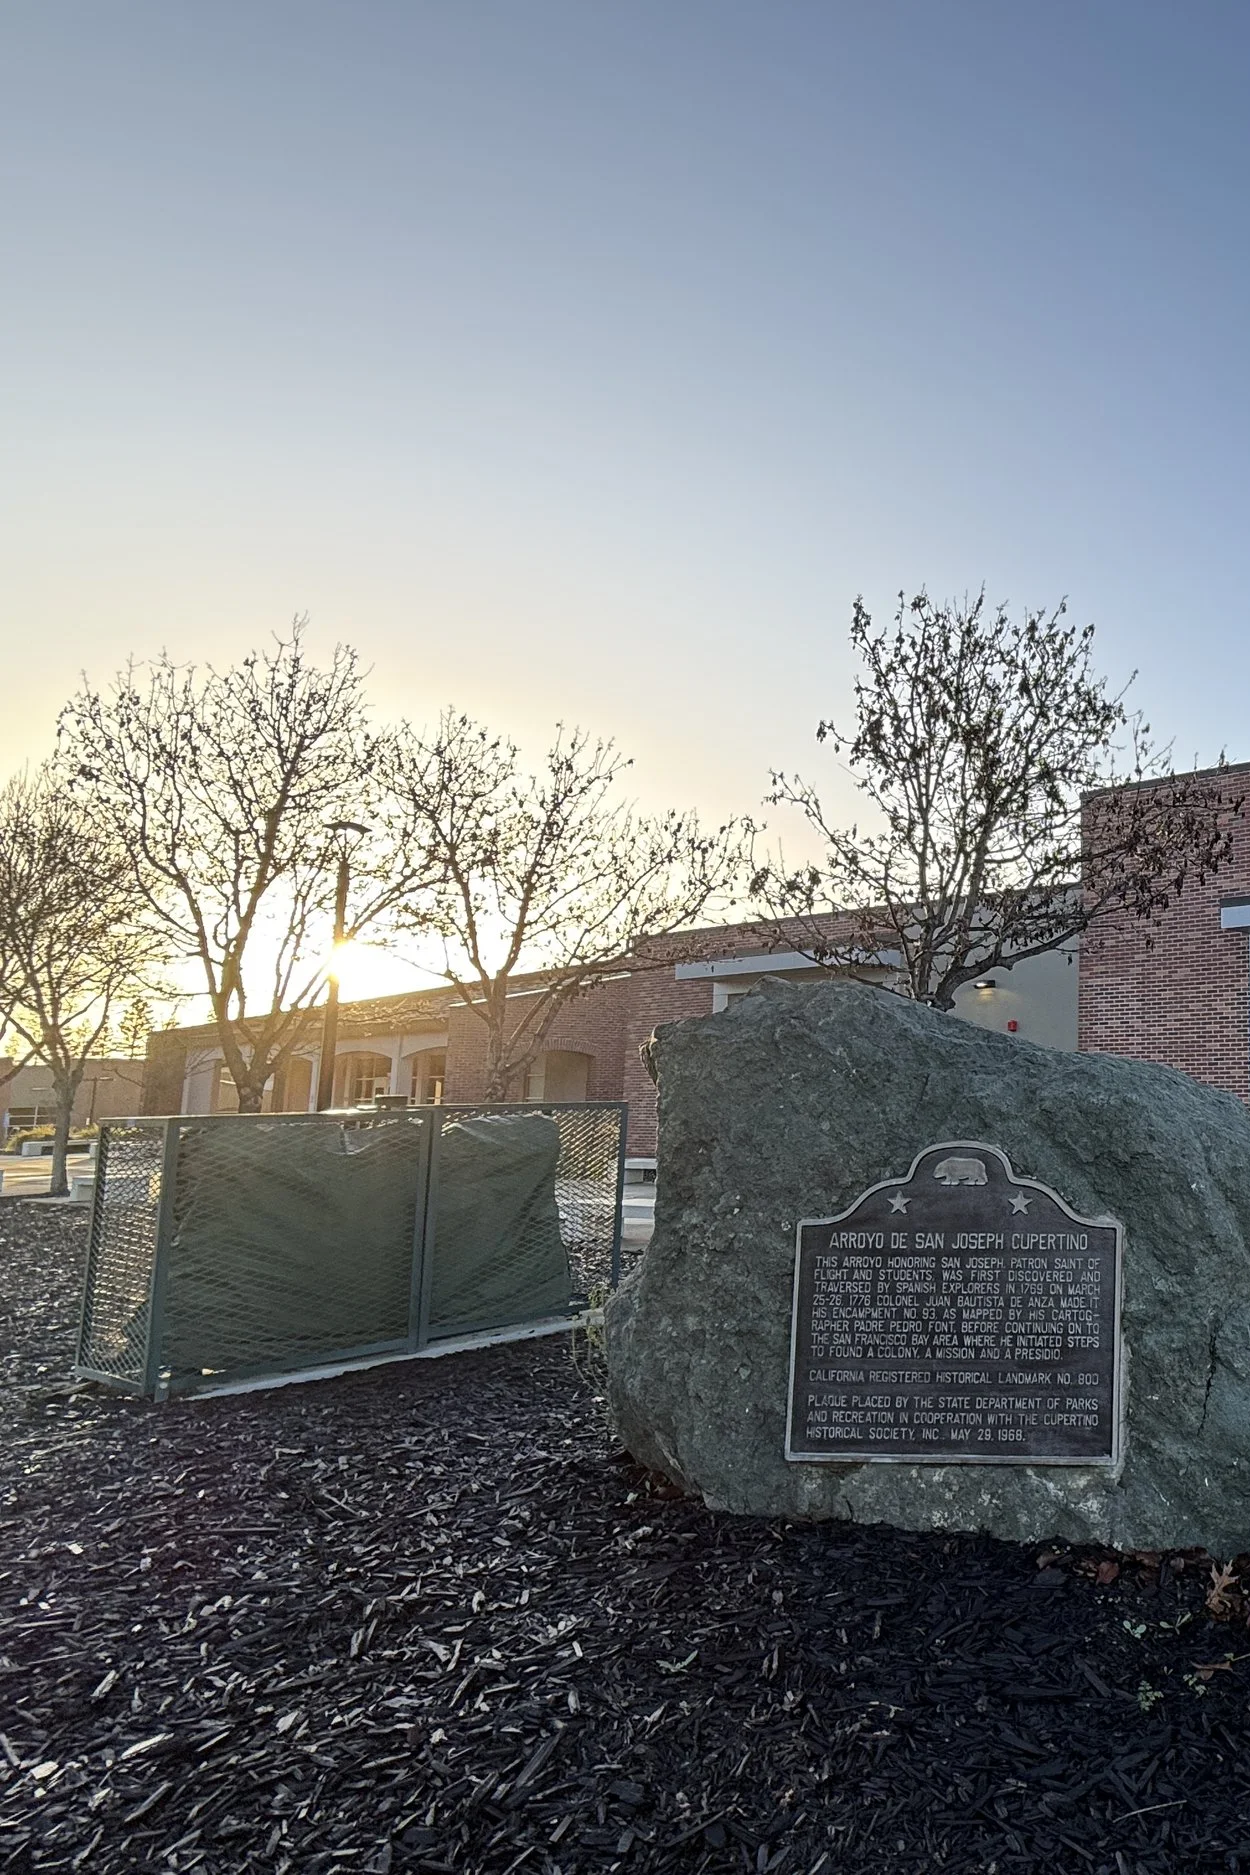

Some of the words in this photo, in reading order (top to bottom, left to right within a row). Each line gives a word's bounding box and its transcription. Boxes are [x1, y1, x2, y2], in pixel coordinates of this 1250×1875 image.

[829, 1232, 884, 1249] ARROYO
[891, 1233, 908, 1249] DE
[915, 1233, 944, 1249] SAN
[952, 1233, 1004, 1249] JOSEPH
[1012, 1234, 1088, 1250] CUPERTINO
[816, 1256, 838, 1267] THIS
[843, 1256, 882, 1268] ARROYO
[888, 1257, 936, 1268] HONORING
[941, 1257, 960, 1268] SAN
[1011, 1258, 1047, 1269] PATRON
[1054, 1258, 1083, 1269] SAINT
[1088, 1258, 1100, 1269] OF
[814, 1269, 848, 1280] FLIGHT
[853, 1269, 872, 1280] AND
[942, 1270, 963, 1281] WAS
[971, 1270, 1000, 1281] FIRST
[1008, 1271, 1073, 1282] DISCOVERED
[1081, 1271, 1100, 1282] AND
[815, 1282, 871, 1293] TRAVERSED
[877, 1282, 890, 1293] BY
[896, 1282, 936, 1293] SPANISH
[942, 1283, 1000, 1294] EXPLORERS
[1006, 1284, 1015, 1294] IN
[1050, 1284, 1063, 1294] ON
[1068, 1284, 1100, 1295] MARCH
[850, 1295, 870, 1305] 1776
[877, 1295, 919, 1306] COLONEL
[926, 1296, 950, 1306] JUAN
[958, 1296, 1004, 1307] BAUTISTA
[1011, 1297, 1023, 1307] DE
[1028, 1297, 1055, 1307] ANZA
[1060, 1297, 1086, 1308] MADE
[1089, 1297, 1100, 1308] IT
[812, 1308, 826, 1318] HIS
[833, 1308, 897, 1319] ENCAMPMENT
[943, 1309, 956, 1319] AS
[963, 1309, 1002, 1320] MAPPED
[1009, 1309, 1022, 1320] BY
[1029, 1310, 1045, 1320] HIS
[1052, 1310, 1100, 1321] CARTOG-
[811, 1320, 849, 1331] RAPHER
[854, 1321, 884, 1332] PADRE
[890, 1321, 922, 1332] PEDRO
[962, 1322, 999, 1333] BEFORE
[1005, 1322, 1063, 1333] CONTINUING
[1068, 1323, 1081, 1333] ON
[1087, 1323, 1099, 1334] TO
[811, 1333, 829, 1344] THE
[833, 1334, 850, 1344] SAN
[855, 1334, 906, 1345] FRANCISCO
[912, 1335, 930, 1345] BAY
[933, 1335, 958, 1346] AREA
[964, 1335, 996, 1346] WHERE
[1000, 1336, 1013, 1346] HE
[1017, 1336, 1062, 1347] INITIATED
[1068, 1336, 1099, 1347] STEPS
[811, 1346, 823, 1357] TO
[830, 1346, 862, 1357] FOUND
[867, 1347, 873, 1357] A
[925, 1347, 932, 1358] A
[936, 1348, 974, 1359] MISSION
[980, 1348, 1000, 1359] AND
[1005, 1349, 1011, 1359] A
[1015, 1349, 1063, 1360] PRESIDIO.
[809, 1370, 864, 1382] CALIFORNIA
[870, 1371, 931, 1383] REGISTERED
[936, 1372, 992, 1384] HISTORICAL
[998, 1372, 1051, 1384] LANDMARK
[808, 1395, 847, 1407] PLAQUE
[852, 1396, 891, 1407] PLACED
[896, 1397, 909, 1407] BY
[914, 1397, 934, 1408] THE
[939, 1397, 970, 1408] STATE
[976, 1397, 1042, 1409] DEPARTMENT
[1047, 1398, 1060, 1409] OF
[1066, 1398, 1098, 1410] PARKS
[807, 1411, 827, 1422] AND
[832, 1411, 894, 1423] RECREATION
[900, 1412, 908, 1423] IN
[914, 1412, 982, 1424] COOPERATION
[988, 1413, 1012, 1425] WITH
[1019, 1414, 1038, 1425] THE
[1044, 1414, 1098, 1426] CUPERTINO
[806, 1427, 863, 1439] HISTORICAL
[951, 1429, 971, 1440] MAY
